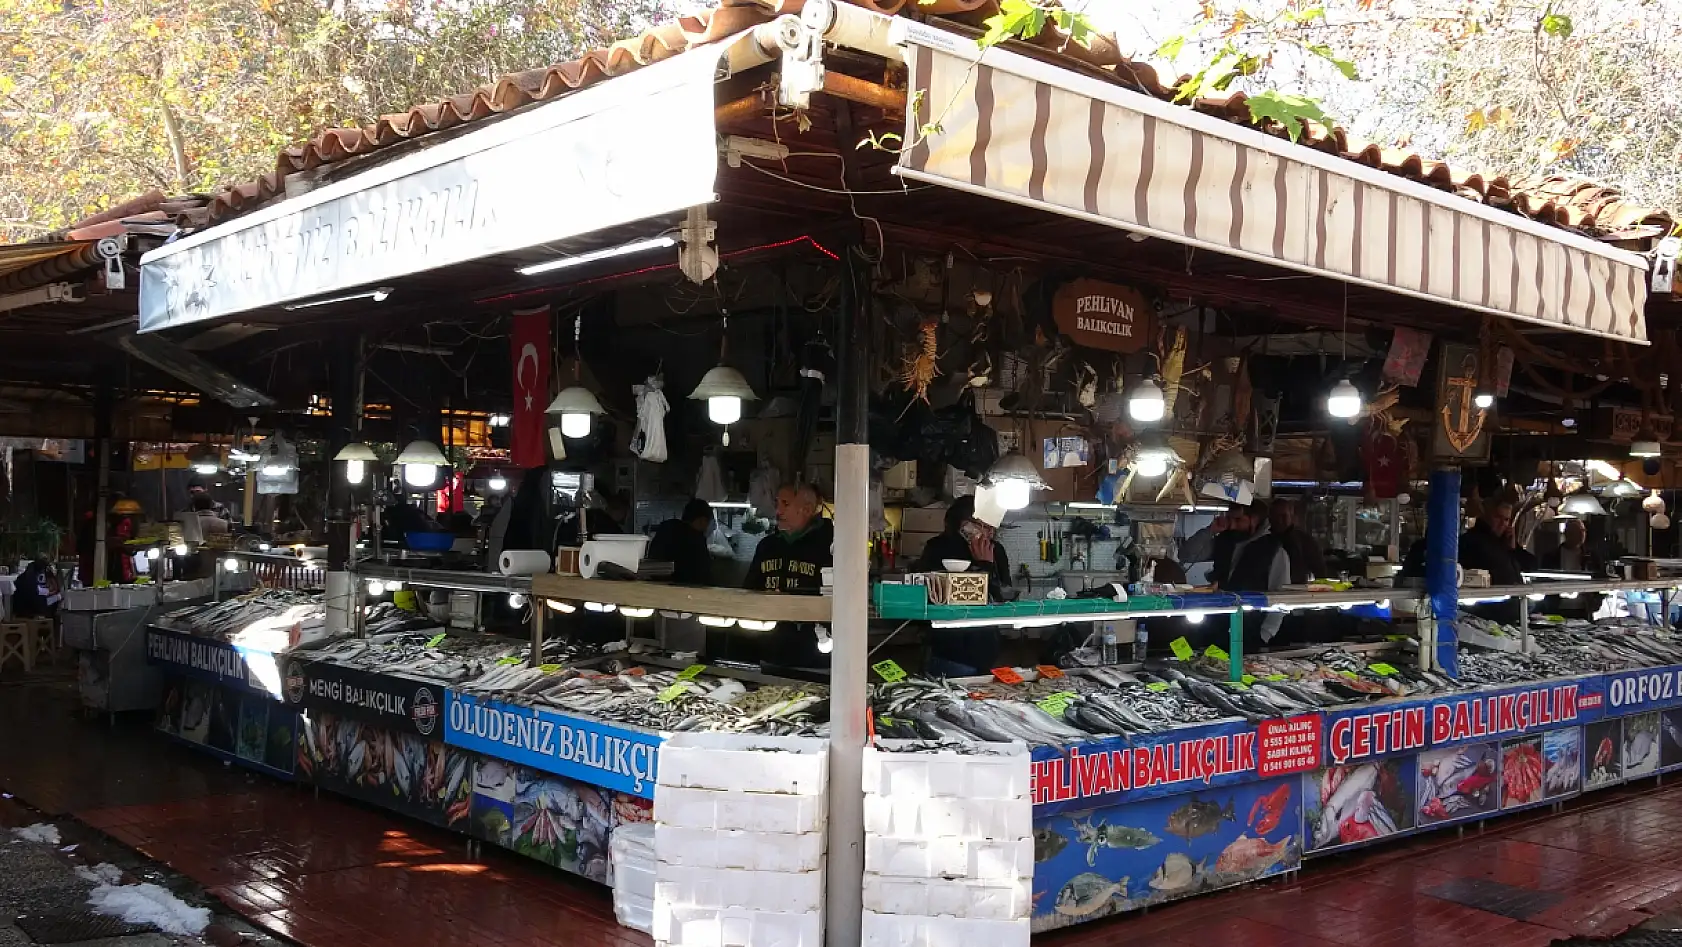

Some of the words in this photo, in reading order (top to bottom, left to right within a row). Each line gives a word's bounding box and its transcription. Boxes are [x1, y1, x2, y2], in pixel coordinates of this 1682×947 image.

[191, 642, 245, 681] BALIKÇILIK
[309, 678, 343, 701] MENGİ
[345, 685, 406, 716] BALIKÇILIK
[1610, 672, 1673, 708] ORFOZ
[1431, 685, 1579, 745] BALIKÇILIK
[1133, 732, 1256, 784] BALIKÇILIK
